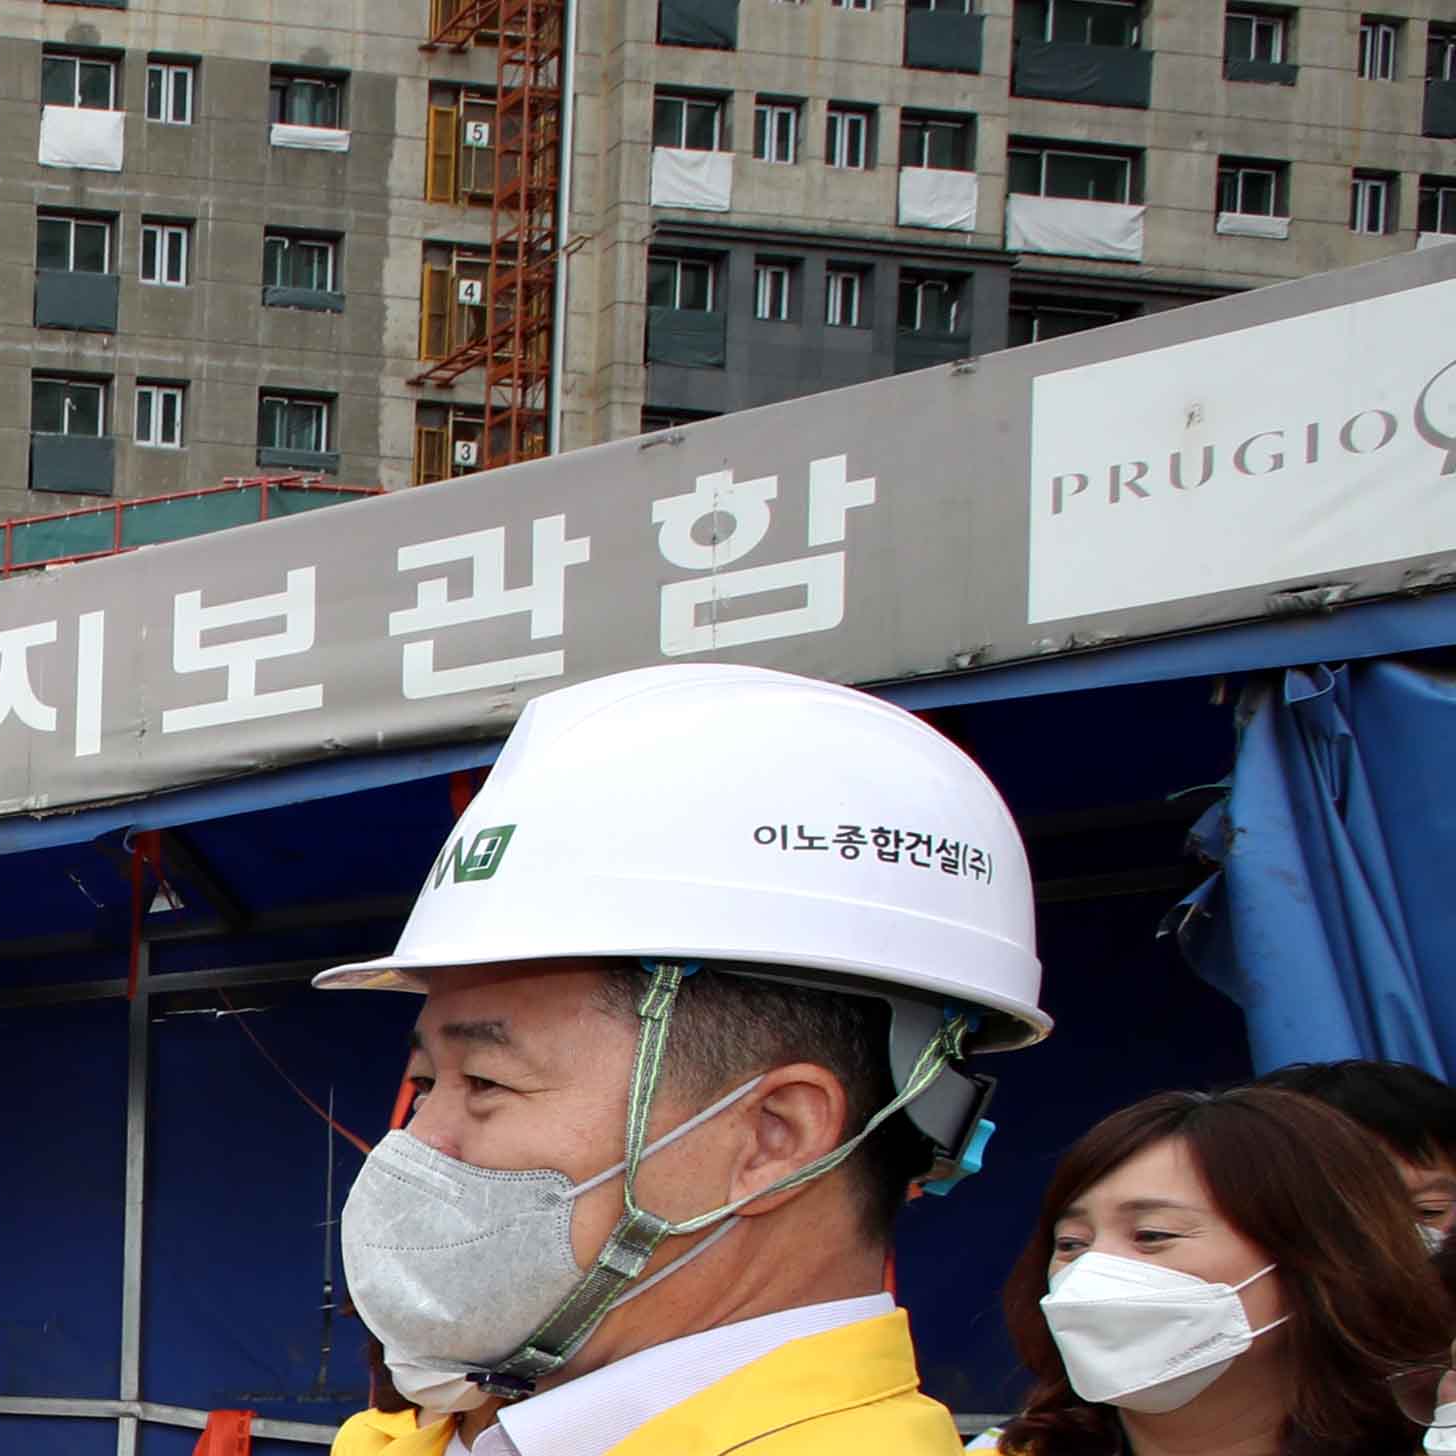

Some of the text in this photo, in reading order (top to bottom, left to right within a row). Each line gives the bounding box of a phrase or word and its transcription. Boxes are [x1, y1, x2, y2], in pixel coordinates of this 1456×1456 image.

[472, 124, 484, 143] 5
[464, 282, 476, 301] 4
[460, 443, 471, 462] 3
[1050, 408, 1399, 516] PRUGIO
[753, 824, 993, 885] 이노종합건설(주)
